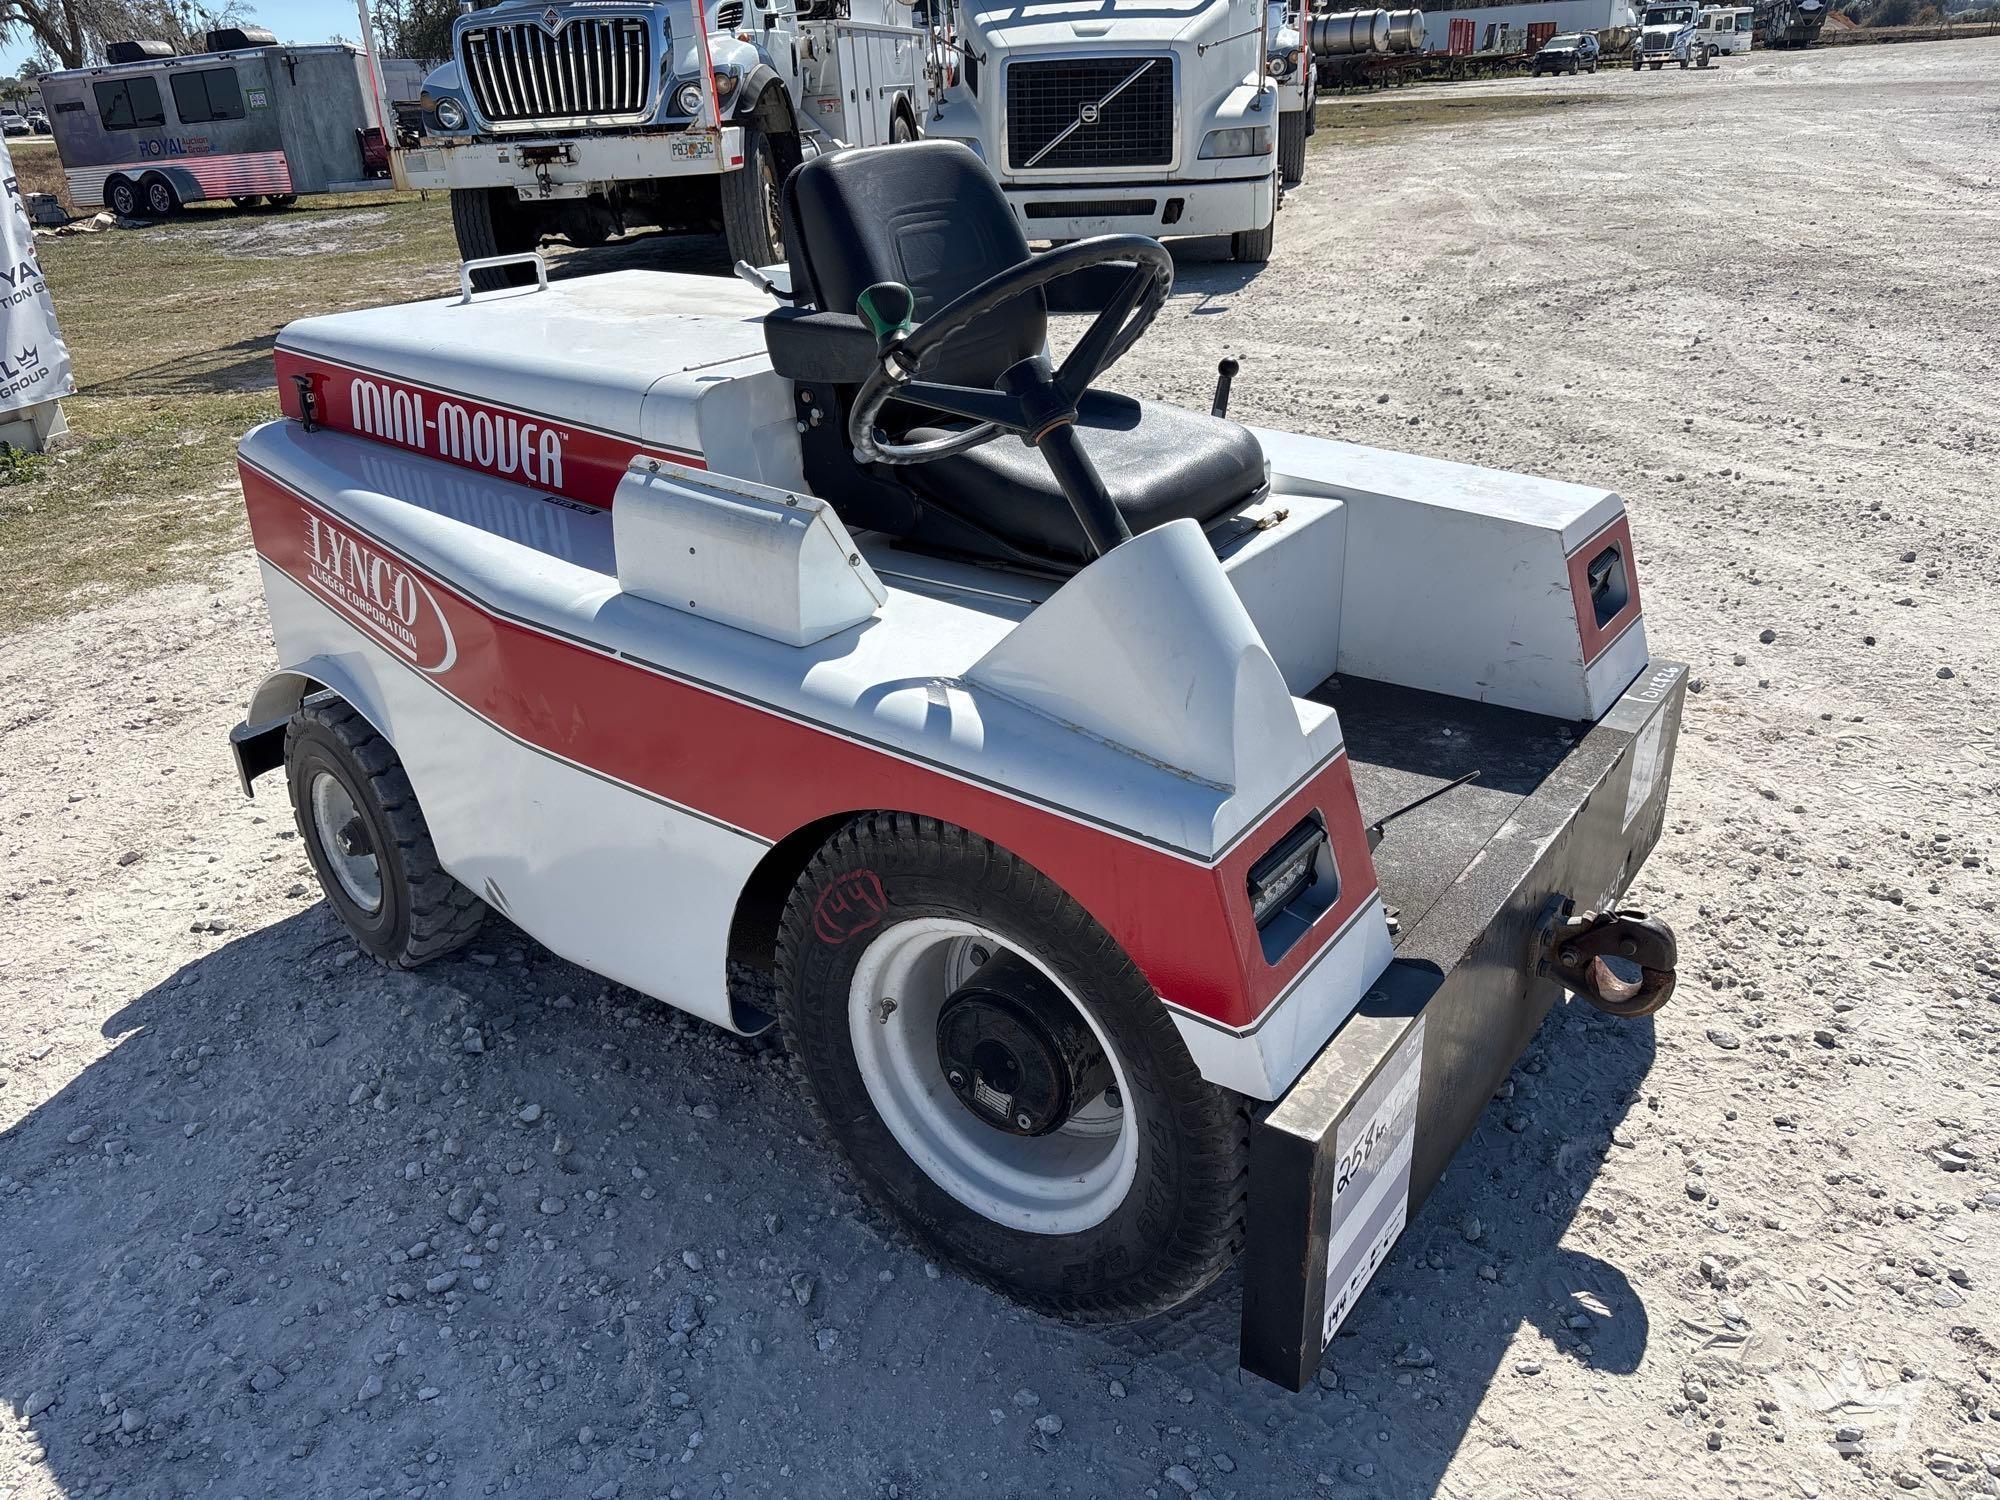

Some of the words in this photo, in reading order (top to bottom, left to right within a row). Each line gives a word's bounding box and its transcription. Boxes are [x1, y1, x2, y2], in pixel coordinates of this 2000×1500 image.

[139, 138, 187, 157] ROYAL
[182, 136, 208, 145] Auction
[187, 146, 210, 154] Group
[0, 367, 50, 399] GROUP
[351, 378, 563, 489] MINI-MOVER
[301, 508, 417, 626] LYNCO
[310, 563, 347, 597] TUGGER
[347, 590, 417, 649] CORPORATION
[820, 881, 881, 933] 144
[1336, 1118, 1377, 1195] 258
[1327, 1290, 1347, 1333] 144
